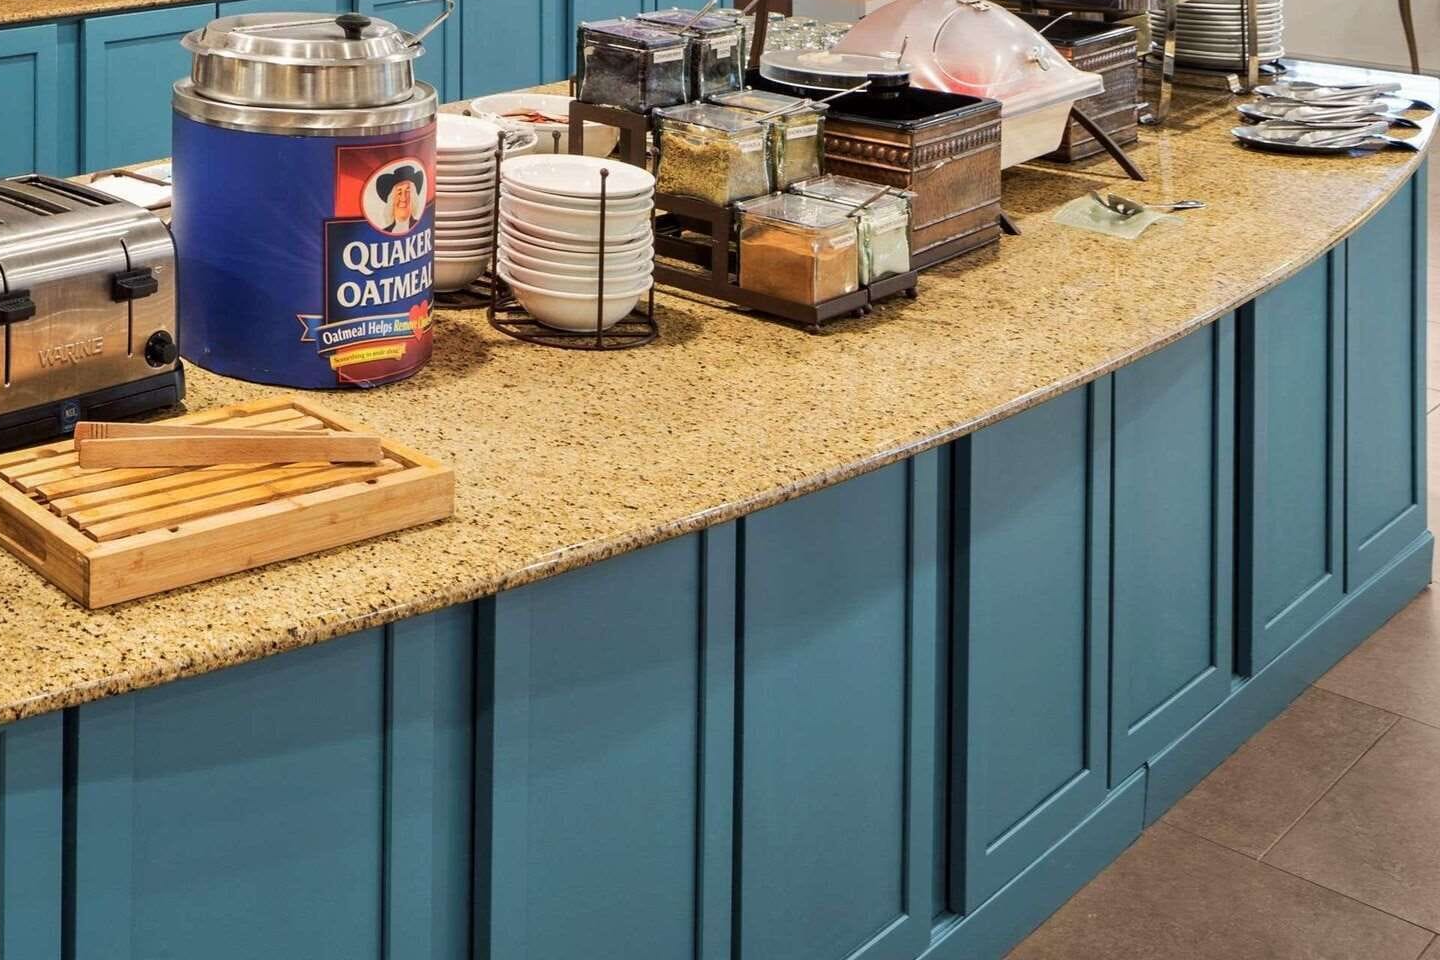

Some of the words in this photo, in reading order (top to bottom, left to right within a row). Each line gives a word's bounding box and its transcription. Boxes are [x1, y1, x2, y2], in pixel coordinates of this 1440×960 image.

[343, 228, 432, 275] QUAKER
[337, 262, 433, 308] OATMEAL
[322, 324, 366, 345] Oatmeal
[368, 319, 392, 337] Helps
[39, 336, 104, 368] WARING
